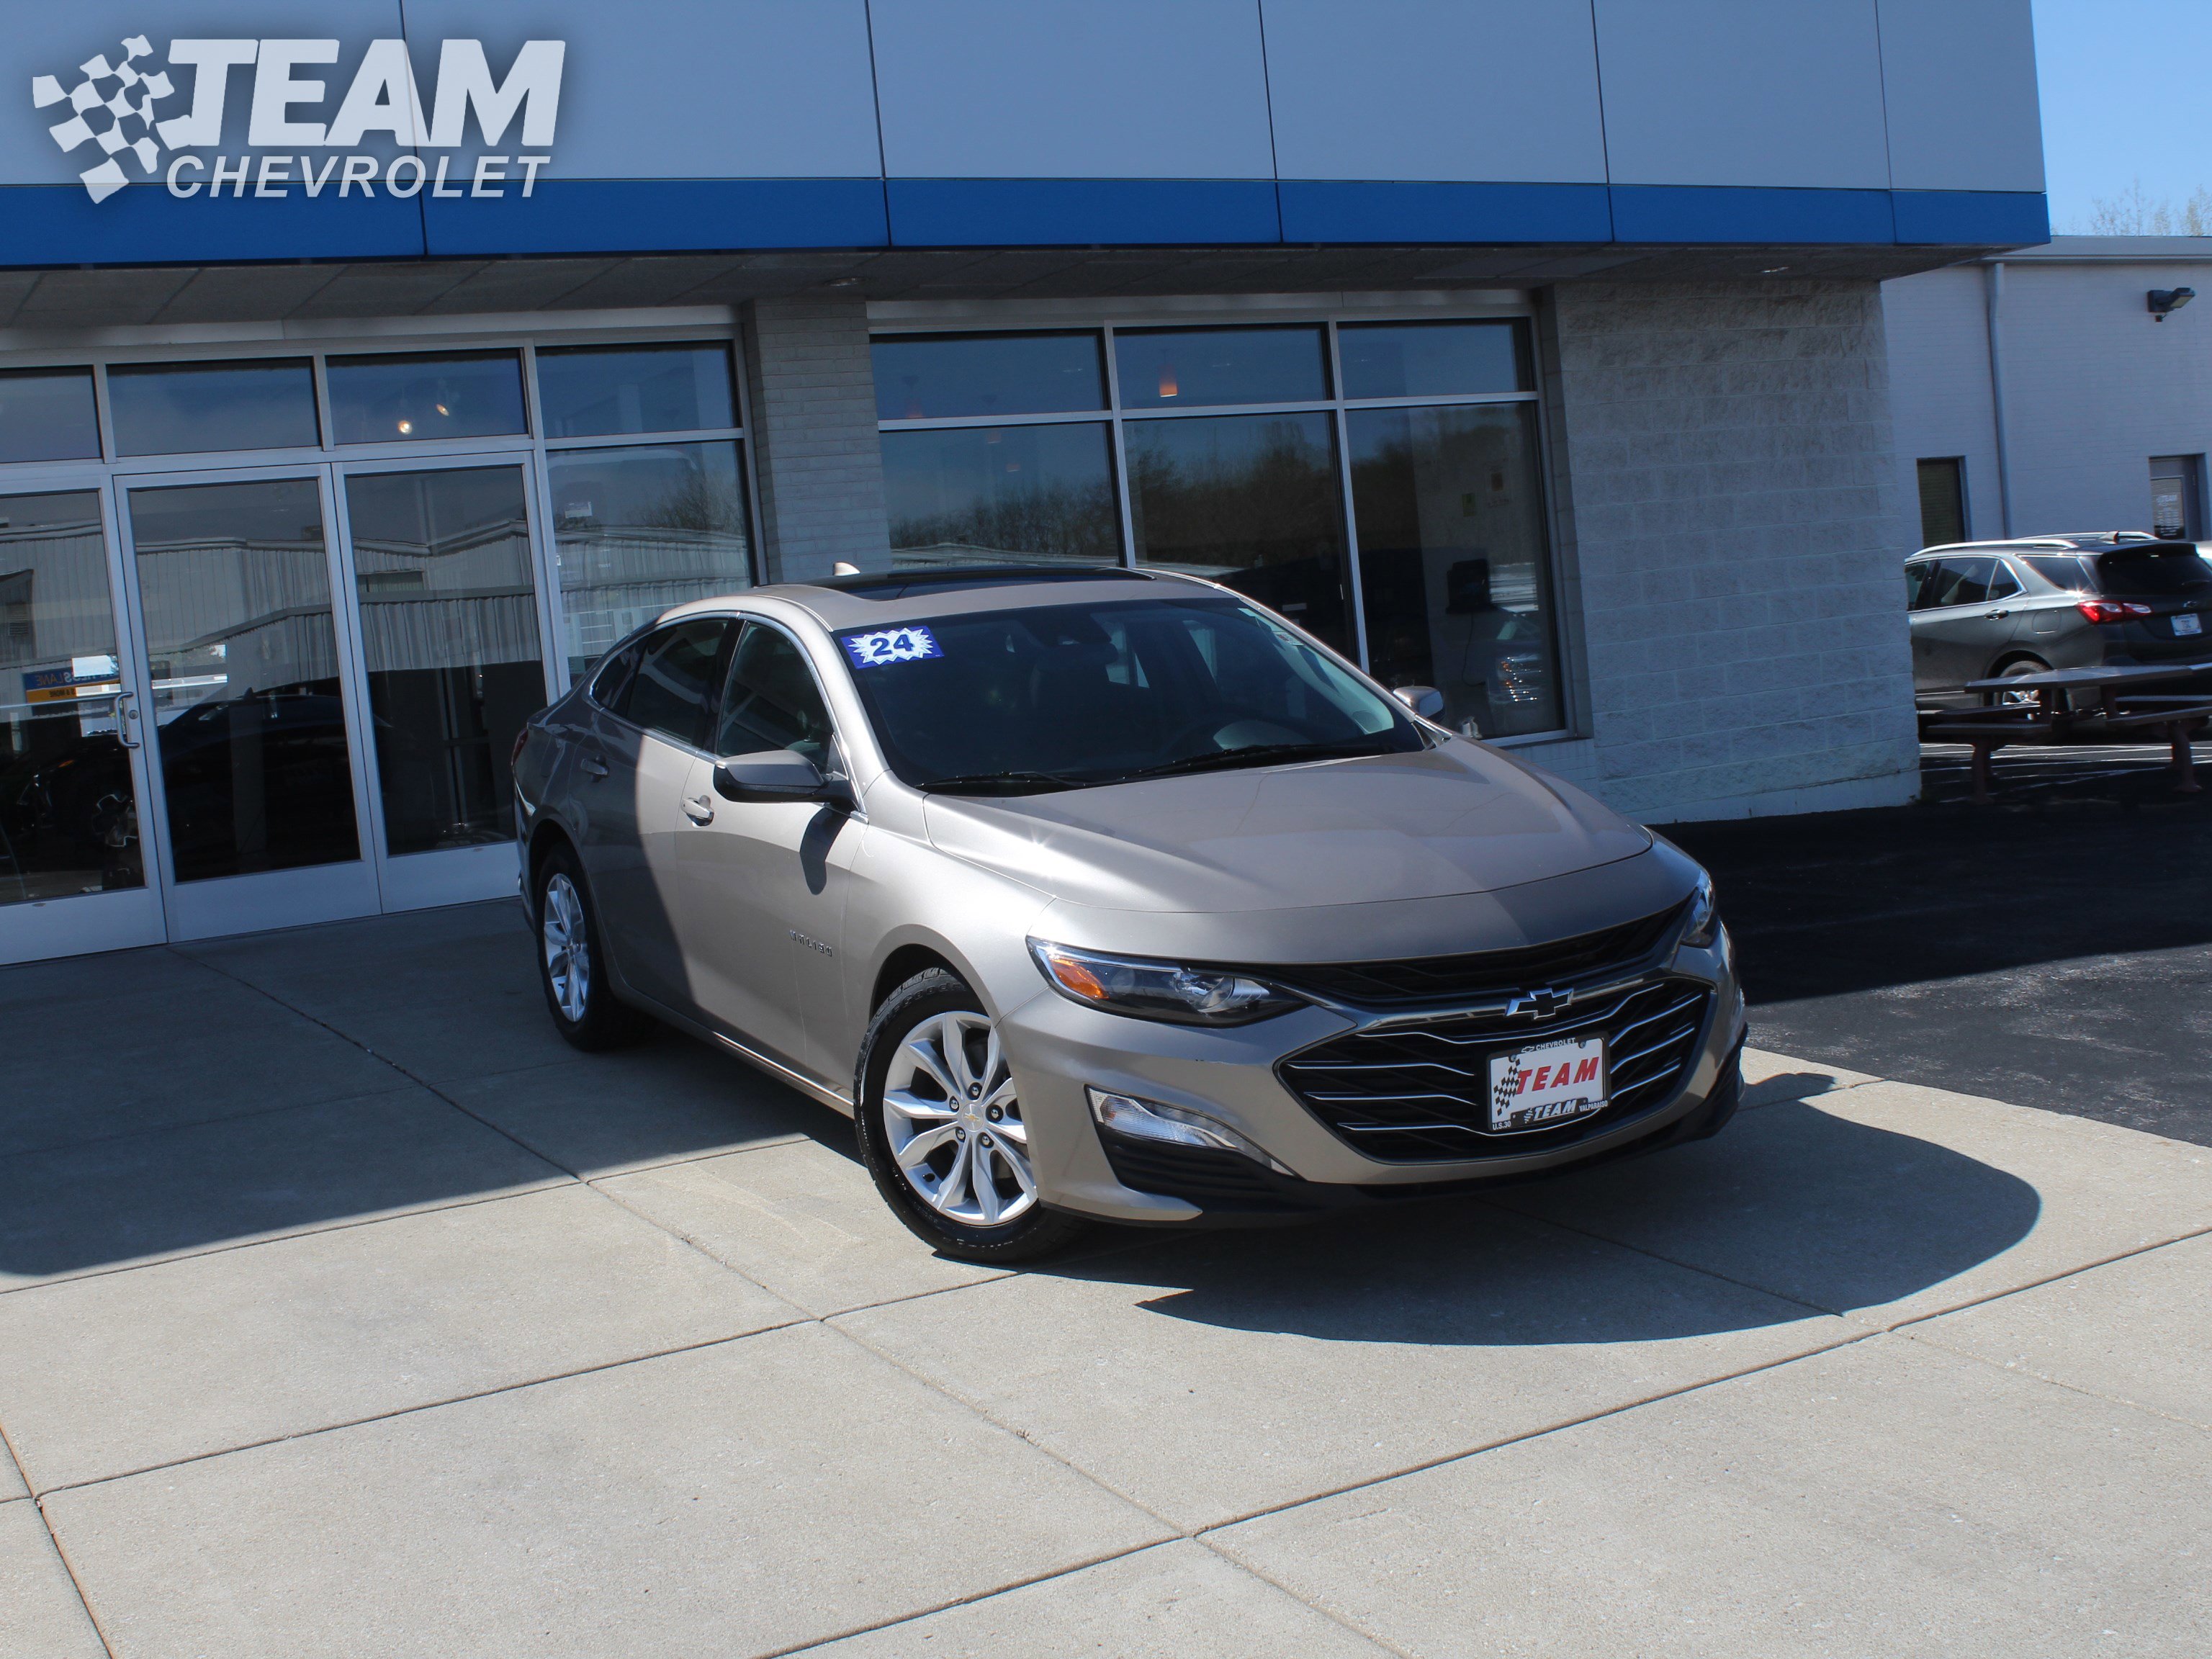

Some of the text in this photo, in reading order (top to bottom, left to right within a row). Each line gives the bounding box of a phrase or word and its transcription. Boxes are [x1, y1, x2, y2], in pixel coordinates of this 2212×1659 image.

[870, 634, 914, 657] 24
[1535, 1037, 1575, 1051] CHEVROLET
[1516, 1056, 1599, 1094] TEAM
[1533, 1099, 1577, 1120] TEAM
[1578, 1100, 1609, 1112] VALPARAISO
